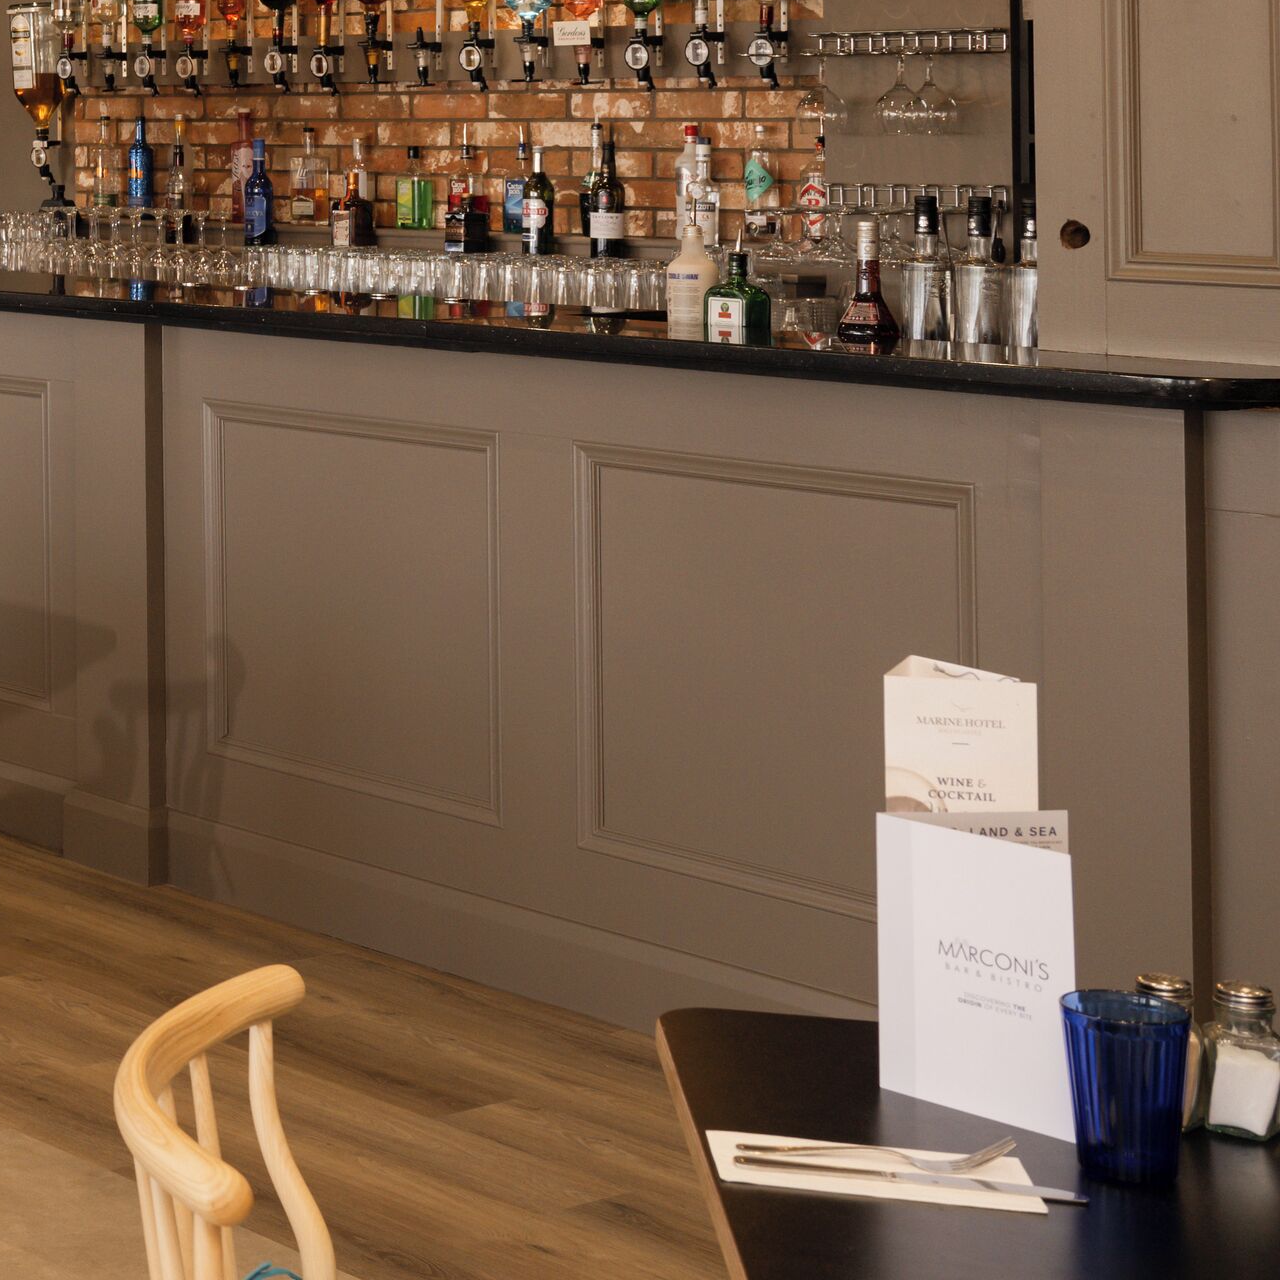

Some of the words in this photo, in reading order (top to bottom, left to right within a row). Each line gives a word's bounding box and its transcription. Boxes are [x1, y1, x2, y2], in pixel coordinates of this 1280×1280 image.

[915, 715, 963, 727] MARINE
[965, 718, 1006, 729] HOTEL
[937, 776, 974, 788] WINE
[977, 778, 987, 789] &
[928, 789, 997, 803] COCKTAIL
[1014, 827, 1023, 837] &
[1029, 826, 1058, 837] SEA
[938, 938, 1050, 981] MARCONI'S
[944, 961, 969, 975] BAR
[991, 972, 1043, 993] BISTRO
[1013, 1003, 1026, 1012] THE
